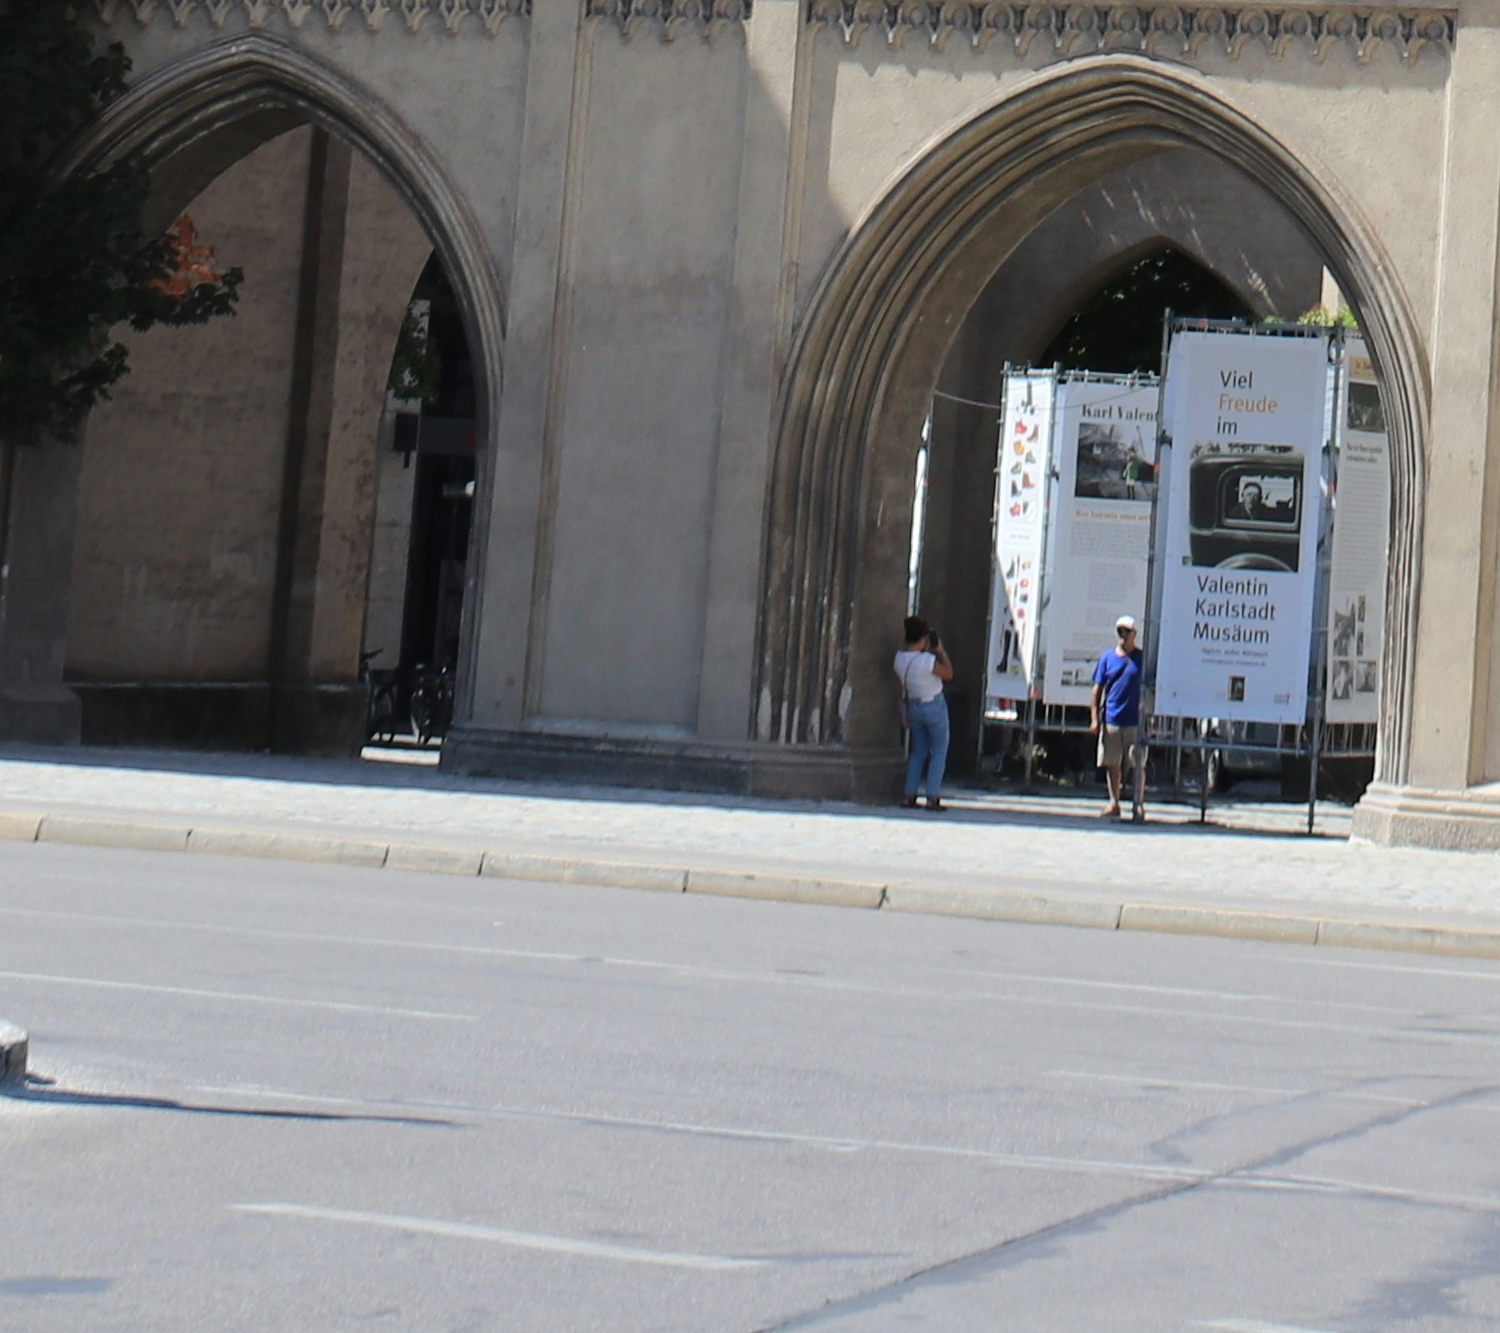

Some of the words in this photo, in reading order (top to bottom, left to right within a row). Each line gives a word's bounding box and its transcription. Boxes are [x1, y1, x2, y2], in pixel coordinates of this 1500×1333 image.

[1220, 371, 1253, 389] Viel
[1081, 404, 1113, 419] Karl
[1219, 394, 1278, 413] Freude
[1216, 416, 1238, 435] im
[1197, 575, 1269, 596] Valentin
[1195, 599, 1276, 621] Karlstadt
[1193, 622, 1270, 645] Musäum
